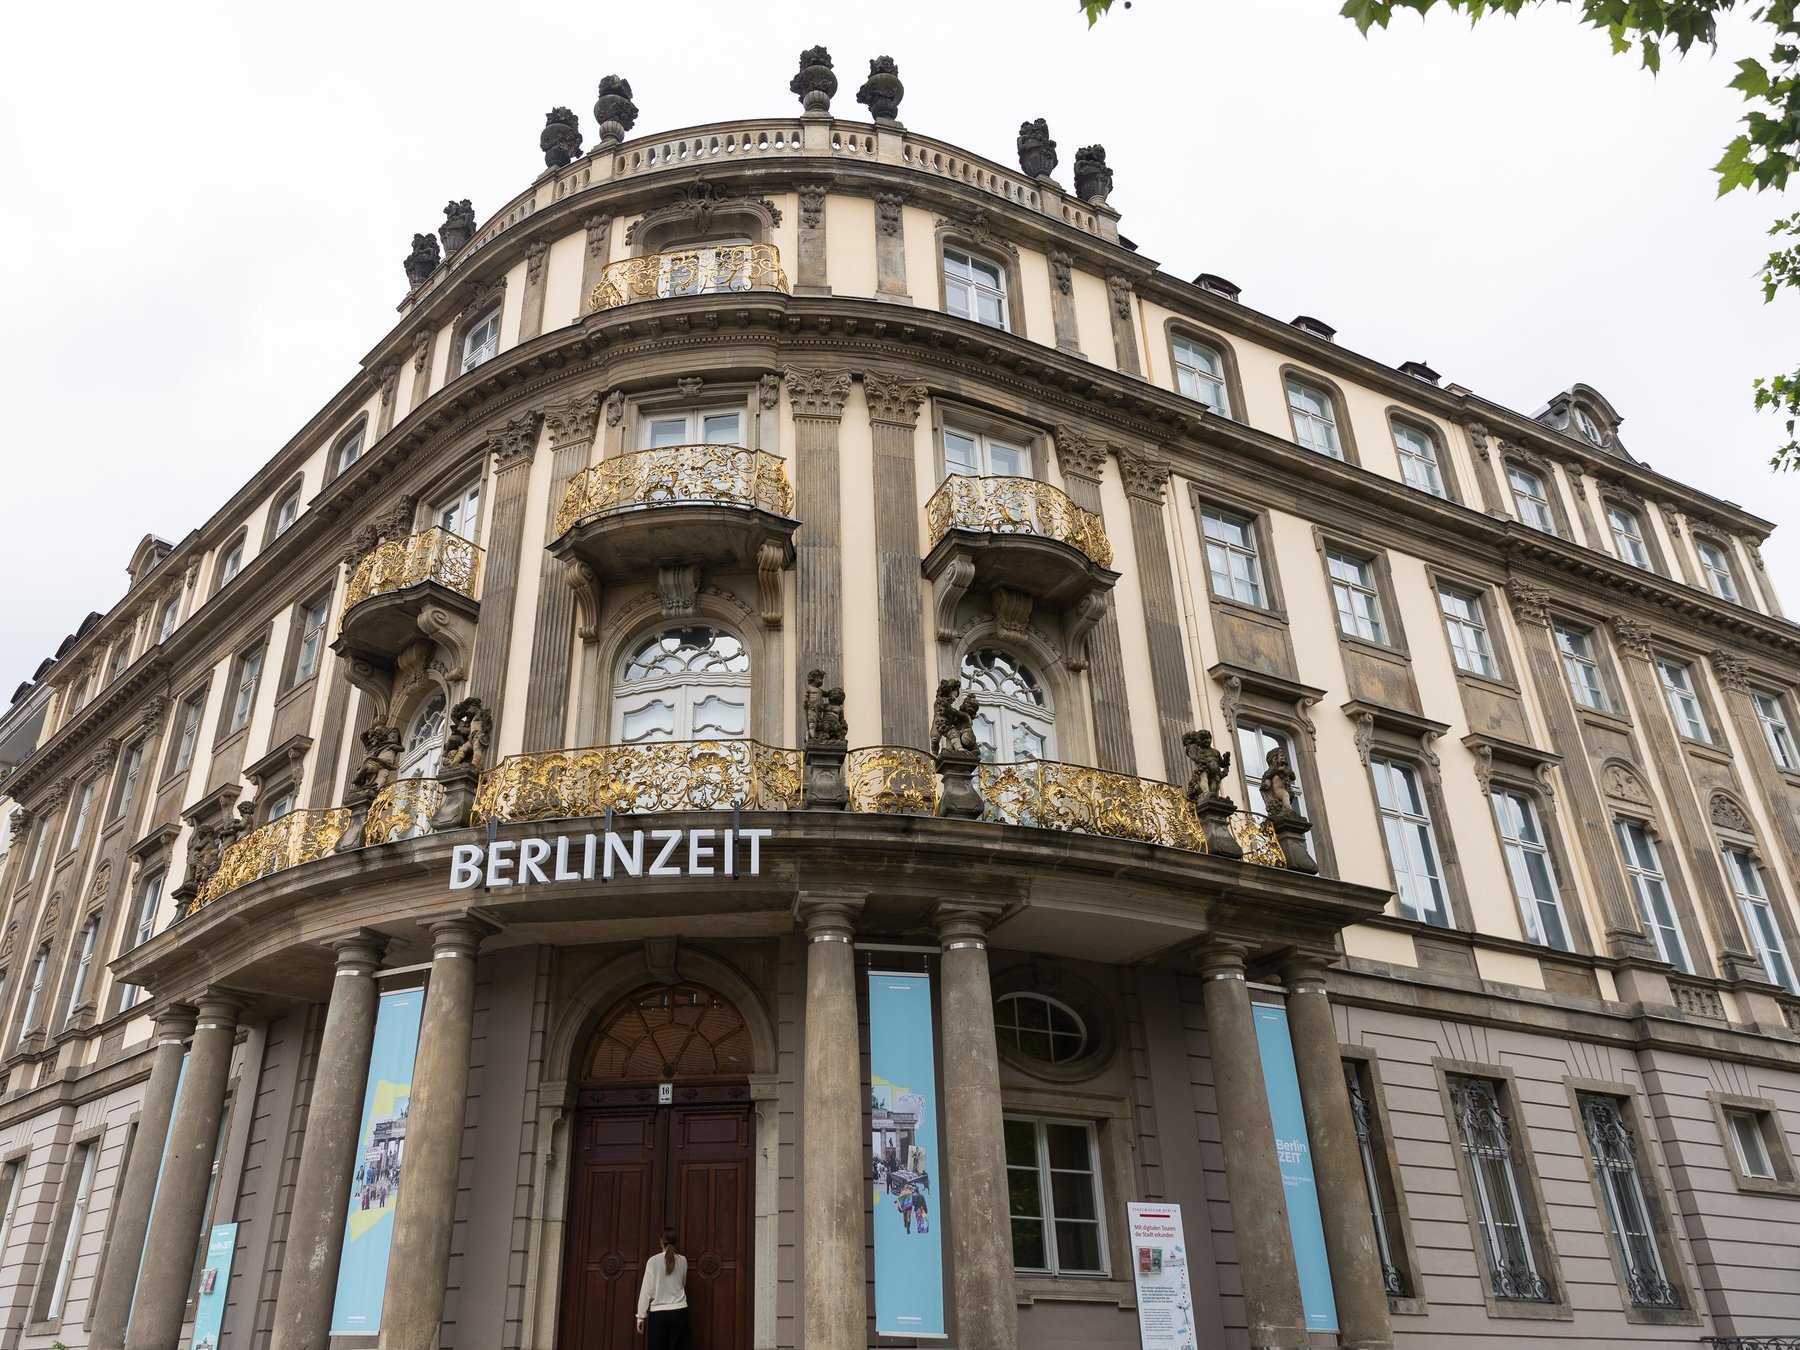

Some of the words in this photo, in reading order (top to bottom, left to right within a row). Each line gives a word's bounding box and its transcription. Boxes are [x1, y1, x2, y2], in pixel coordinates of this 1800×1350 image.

[449, 828, 773, 891] BERLINZEIT
[662, 1087, 669, 1095] 16
[1276, 1139, 1306, 1152] Berlin
[1278, 1151, 1301, 1163] ZEIT
[1142, 1224, 1161, 1232] digitalen
